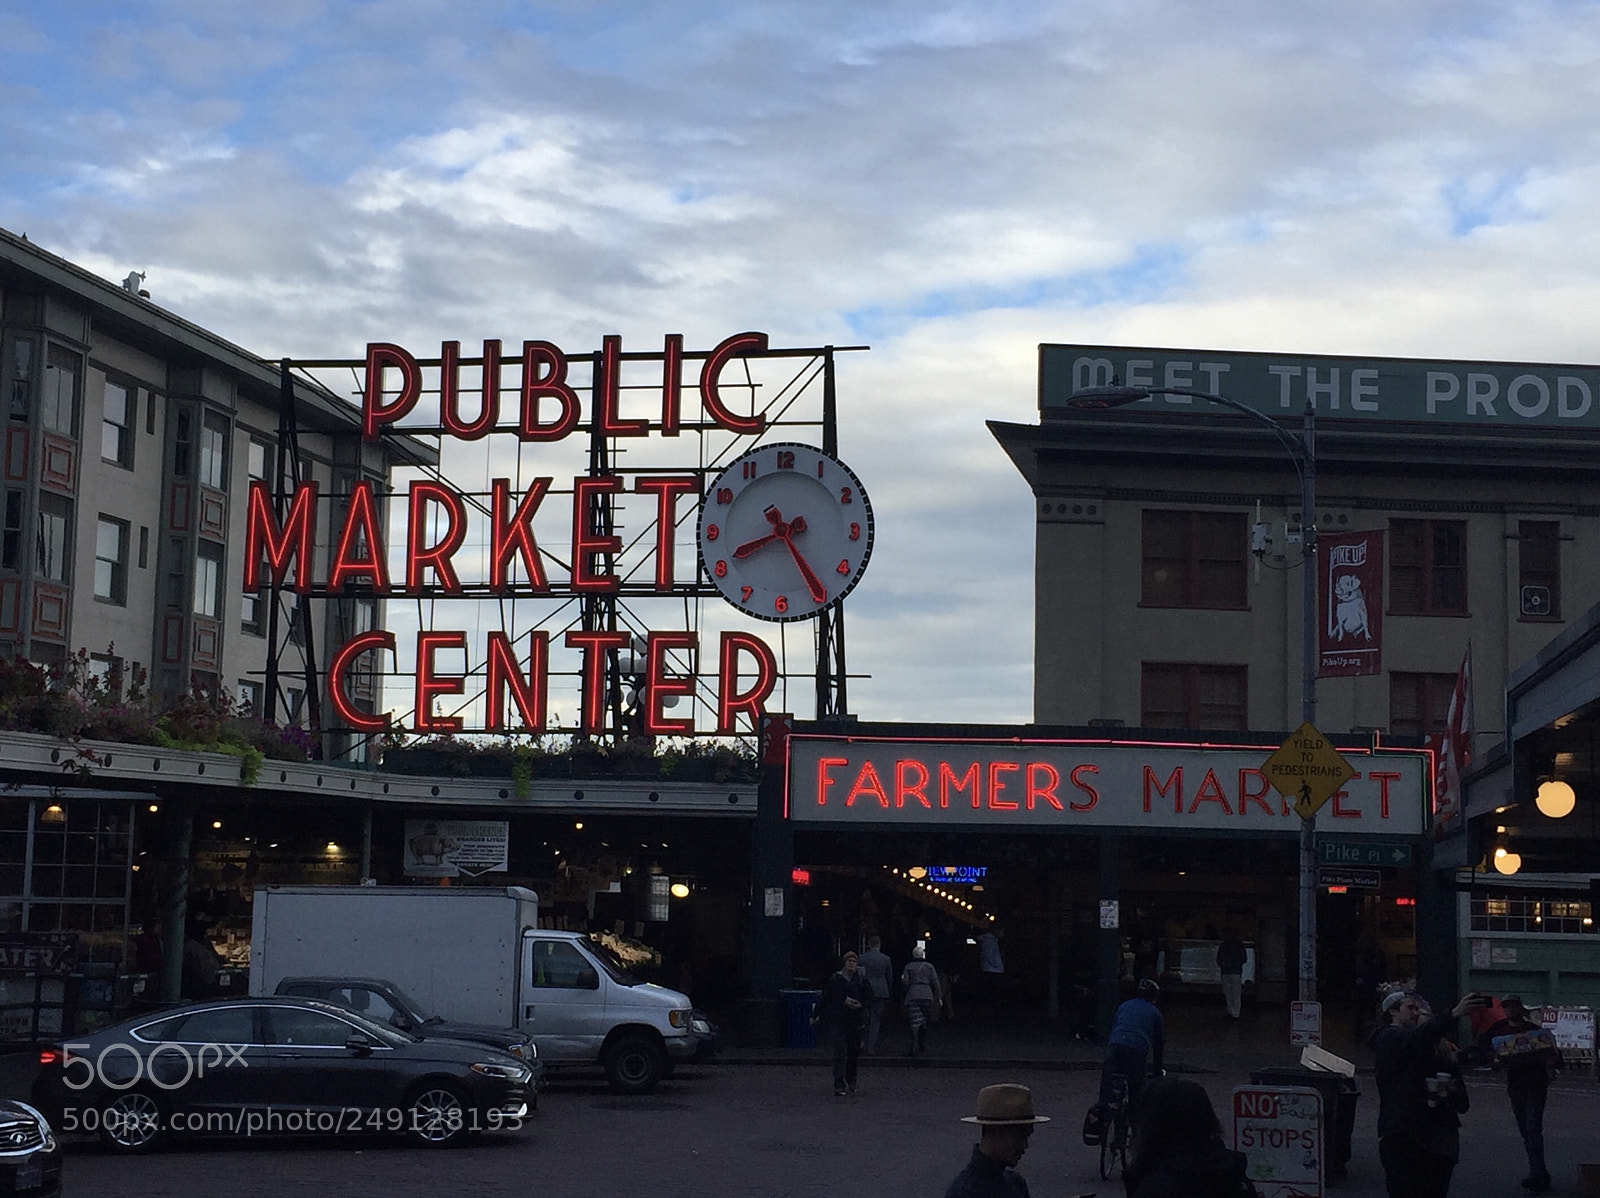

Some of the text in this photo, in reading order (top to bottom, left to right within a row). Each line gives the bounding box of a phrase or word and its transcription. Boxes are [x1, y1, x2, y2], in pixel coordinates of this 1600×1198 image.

[363, 331, 769, 442] PUBLIC
[1073, 357, 1600, 418] MEET THE PROD
[777, 452, 794, 469] 12
[743, 461, 756, 479] 11
[817, 461, 824, 478] 1
[717, 488, 733, 504] 10
[841, 487, 852, 503] 2
[244, 476, 700, 594] MARKET
[707, 524, 719, 540] 9
[849, 522, 860, 540] 3
[715, 560, 727, 577] 8
[836, 559, 850, 576] 4
[741, 586, 753, 602] 7
[775, 596, 788, 613] 6
[328, 630, 778, 736] CENTER
[1292, 739, 1324, 750] YIELD
[1301, 751, 1314, 763] TO
[1272, 765, 1342, 777] PEDESTRIANS
[817, 757, 1099, 811] FARMERS
[1325, 843, 1360, 861] Pike
[1543, 1012, 1556, 1021] NO
[1240, 1094, 1274, 1116] NO
[1241, 1127, 1315, 1149] STOPS
